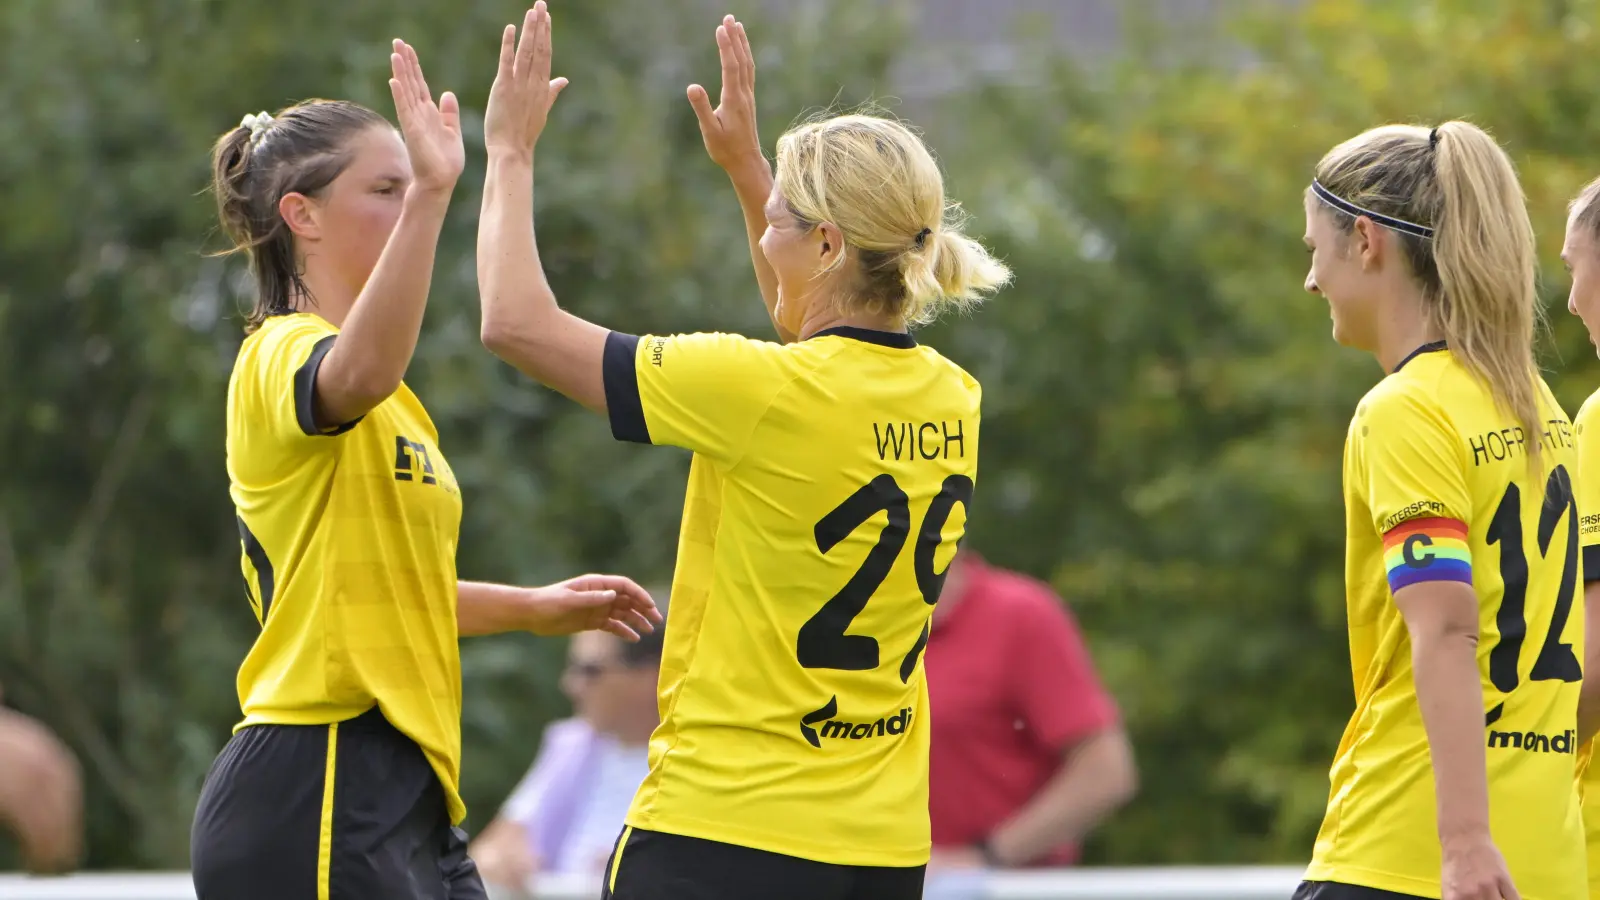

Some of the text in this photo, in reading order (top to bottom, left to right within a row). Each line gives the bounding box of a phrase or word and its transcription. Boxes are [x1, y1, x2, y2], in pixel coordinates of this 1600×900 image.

[873, 419, 965, 461] WICH
[1402, 532, 1436, 570] C
[796, 473, 974, 685] 29
[1486, 463, 1583, 694] 12
[820, 706, 913, 740] mondi
[1487, 729, 1575, 755] mondi
